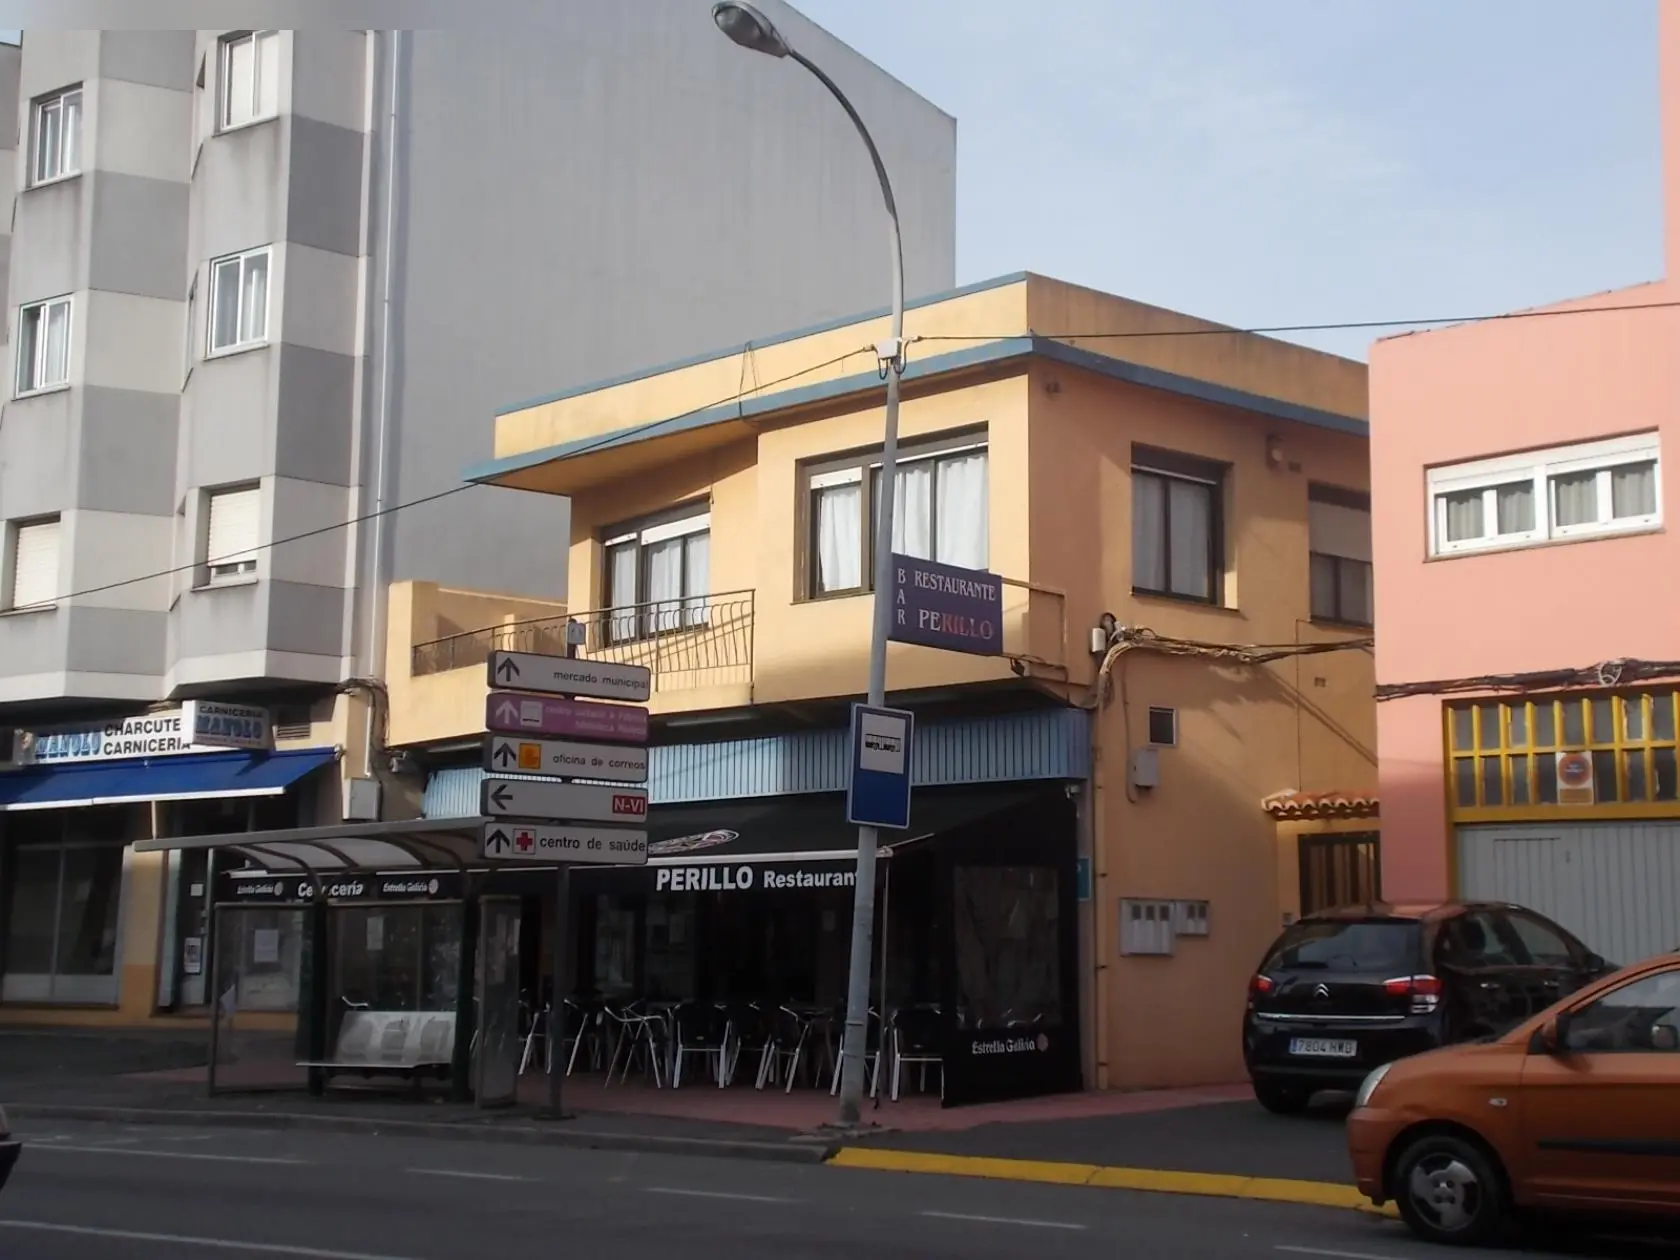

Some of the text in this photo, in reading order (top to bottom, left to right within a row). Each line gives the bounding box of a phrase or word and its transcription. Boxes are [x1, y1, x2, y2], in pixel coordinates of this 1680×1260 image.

[896, 567, 906, 625] BAR
[914, 570, 997, 601] RESTAURANTE
[919, 608, 995, 640] PERILLO
[553, 671, 598, 684] mercado
[552, 754, 645, 770] oficina de correos
[614, 799, 643, 813] N-VI
[540, 836, 645, 852] centro de saúde
[656, 866, 754, 892] PERILLO
